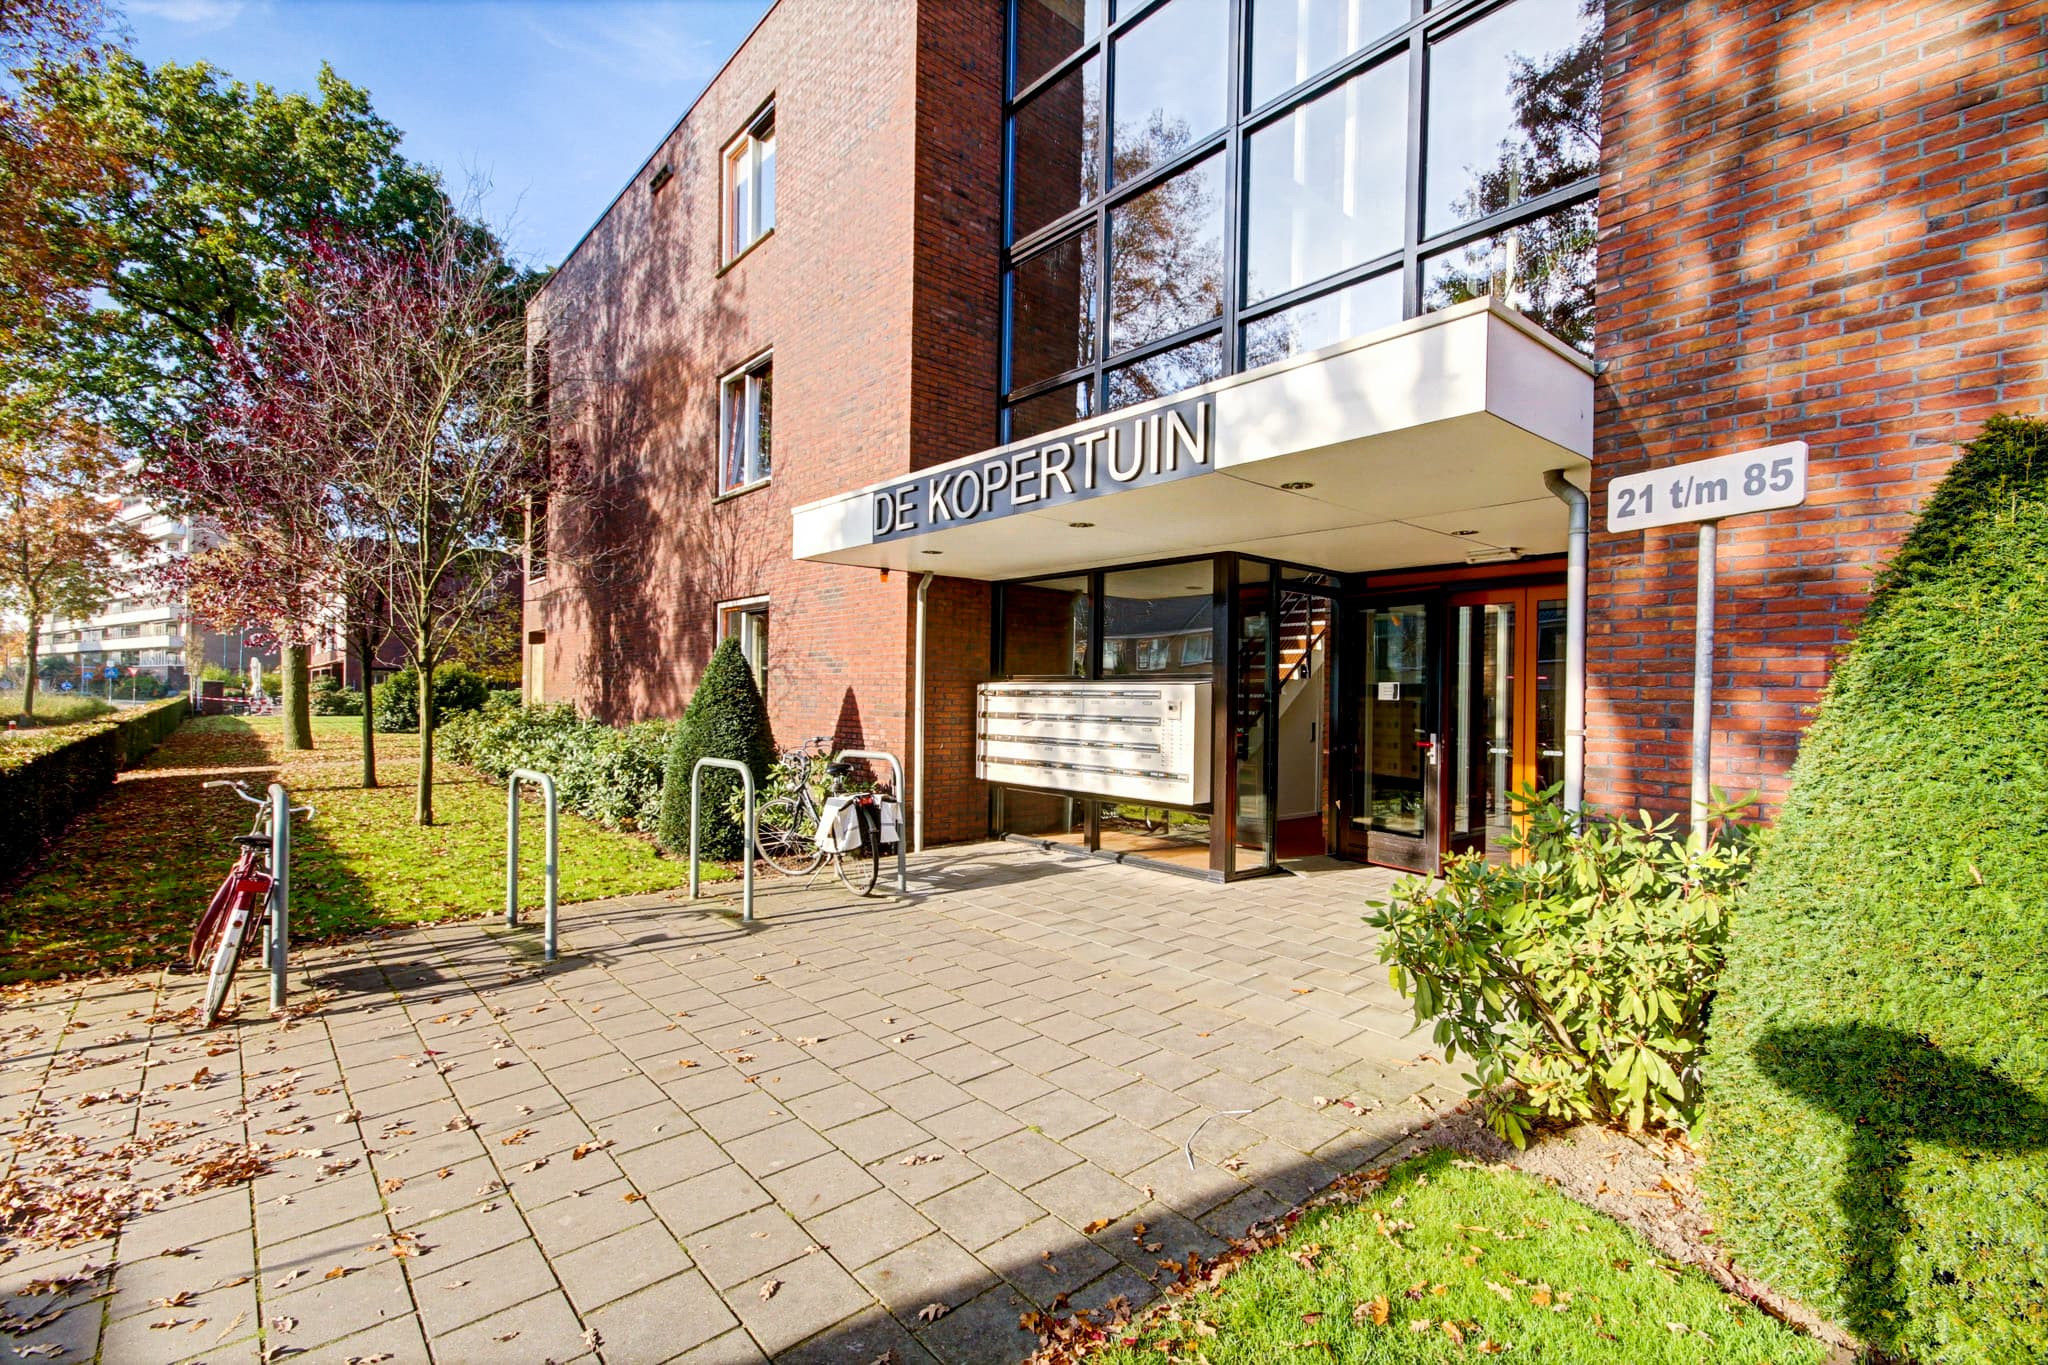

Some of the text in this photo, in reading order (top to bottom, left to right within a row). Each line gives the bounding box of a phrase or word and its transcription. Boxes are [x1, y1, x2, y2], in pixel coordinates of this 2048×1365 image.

[874, 401, 1209, 536] DE KOPERTUIN
[1616, 457, 1794, 519] 21 t/m 85
